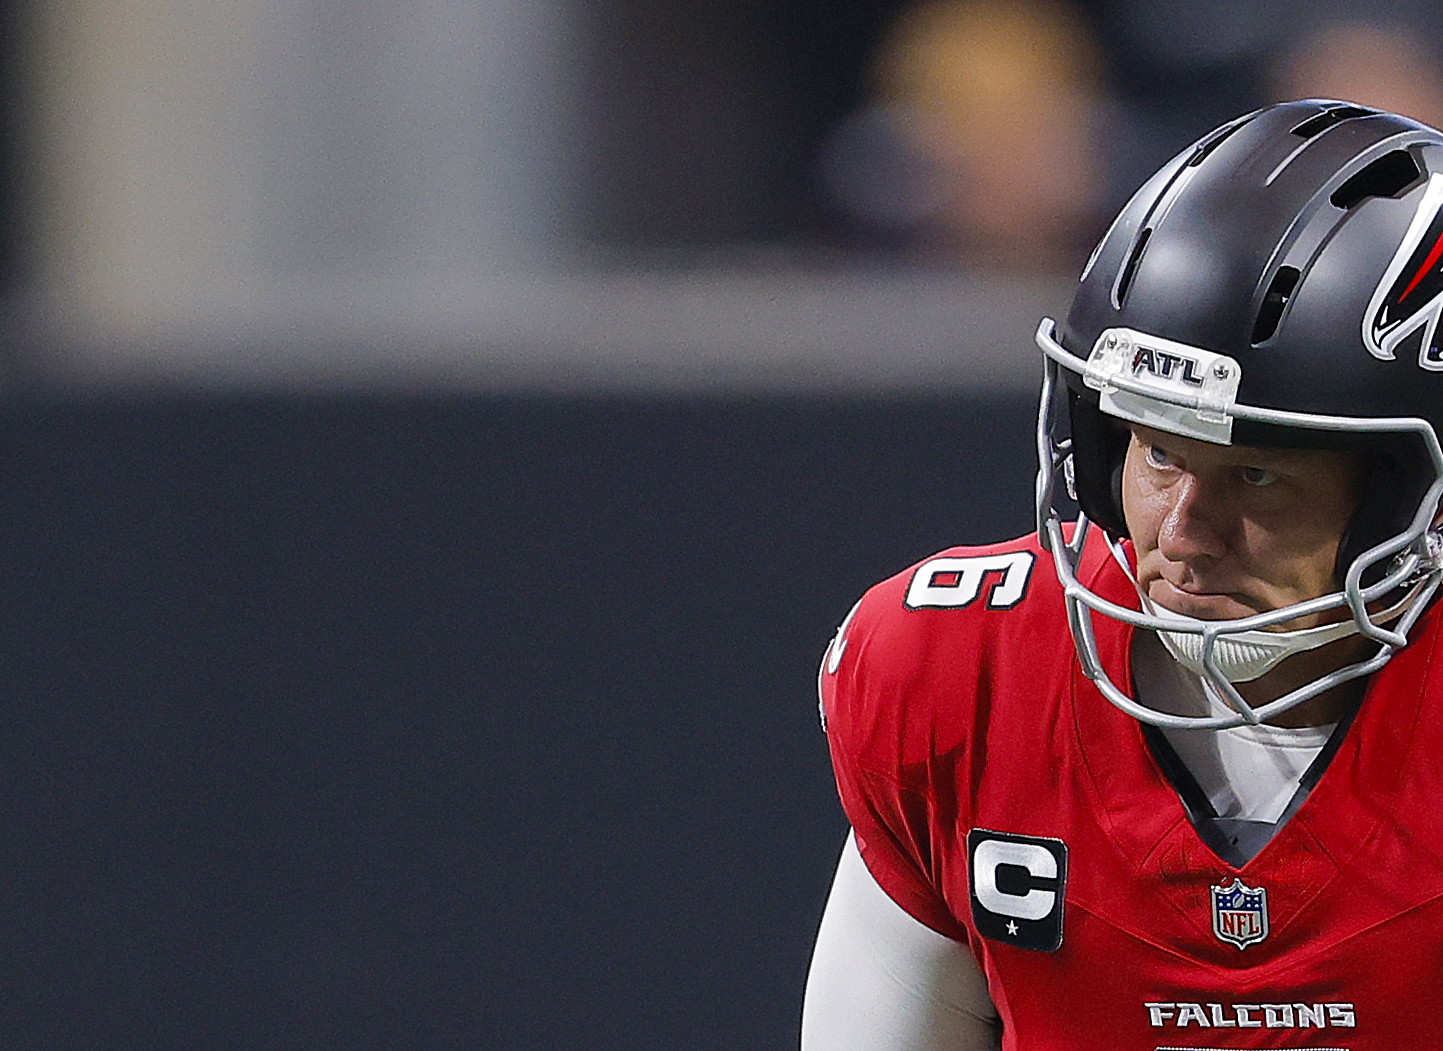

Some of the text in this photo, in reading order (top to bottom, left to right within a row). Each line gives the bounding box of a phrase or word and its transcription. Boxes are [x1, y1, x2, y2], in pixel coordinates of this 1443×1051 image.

[1131, 346, 1204, 387] ATL
[903, 550, 1037, 611] 6
[973, 838, 1059, 921] C
[1221, 911, 1259, 938] NFL
[1143, 1001, 1357, 1029] FALCONS
